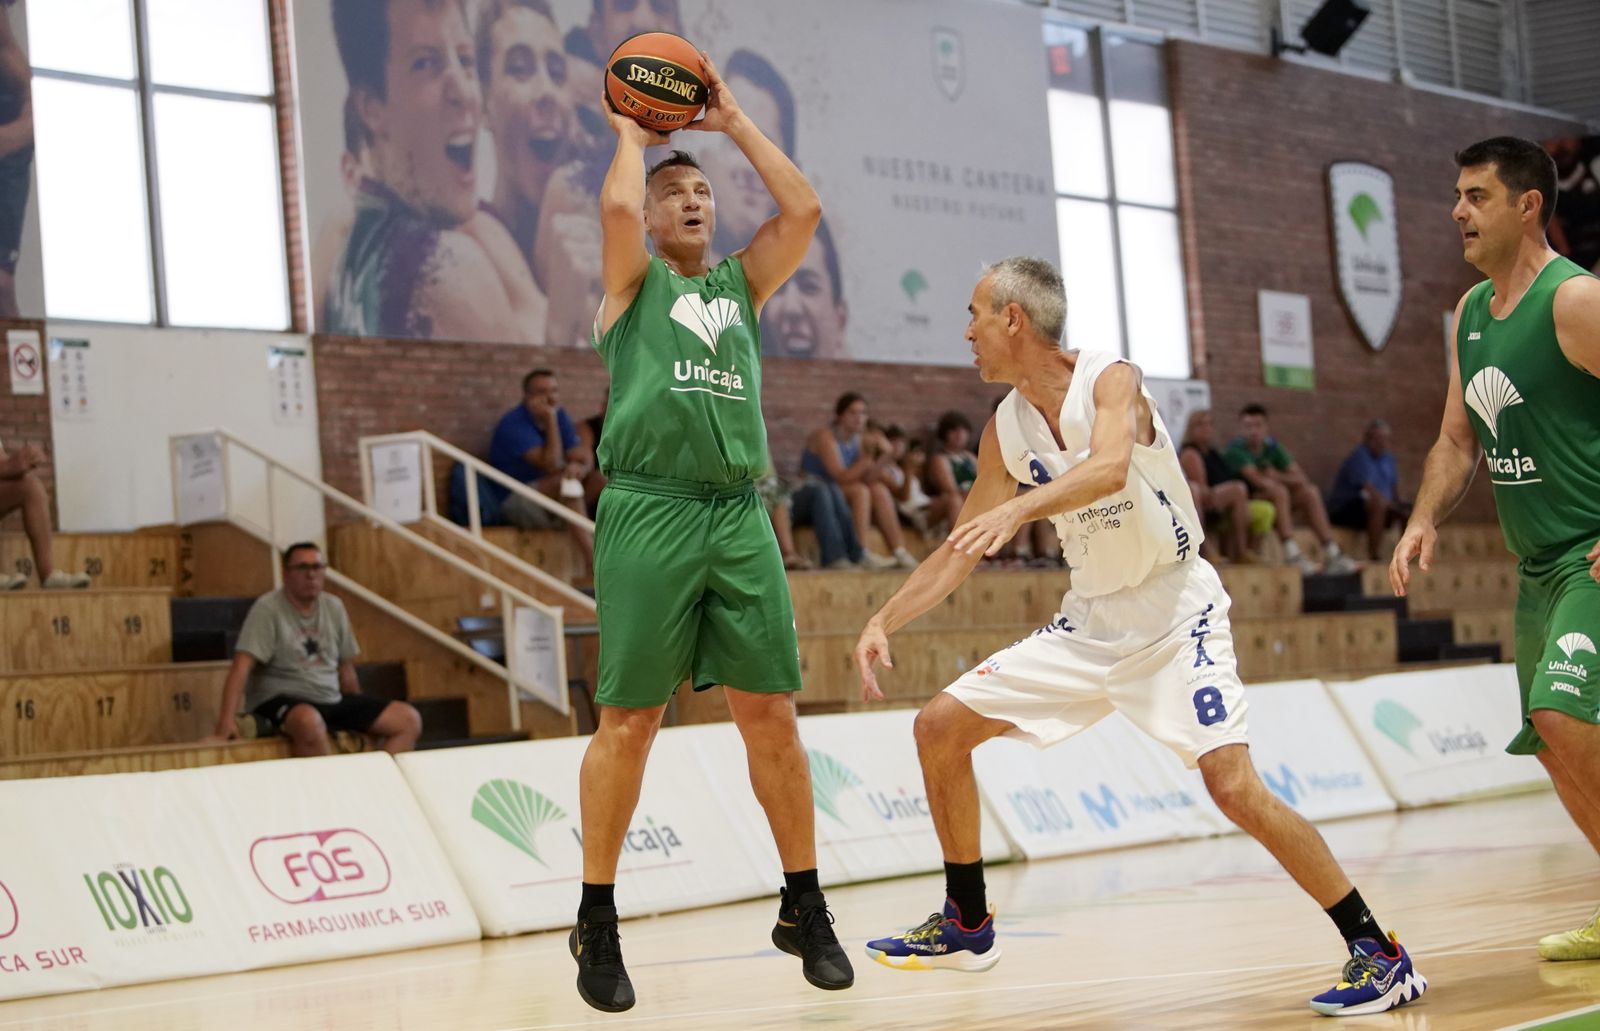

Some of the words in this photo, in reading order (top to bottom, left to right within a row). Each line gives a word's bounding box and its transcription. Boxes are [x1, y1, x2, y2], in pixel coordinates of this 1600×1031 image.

[627, 63, 698, 103] SPALDING
[863, 155, 954, 184] NUESTRA
[962, 166, 1046, 196] CANTERA
[674, 358, 743, 393] Unicaja
[1484, 447, 1537, 479] nicaja
[84, 558, 103, 576] 20
[149, 558, 167, 577] 21
[52, 615, 72, 636] 18
[124, 615, 142, 634] 19
[1548, 660, 1587, 678] Unicaja
[15, 699, 35, 720] 16
[96, 696, 115, 717] 17
[1193, 686, 1228, 726] 8
[1427, 723, 1488, 756] Unicaja
[866, 786, 928, 820] Unic
[571, 815, 682, 858] caja
[248, 908, 403, 943] FARMAQUIMICA
[407, 900, 450, 921] SUR
[36, 947, 88, 970] SUR
